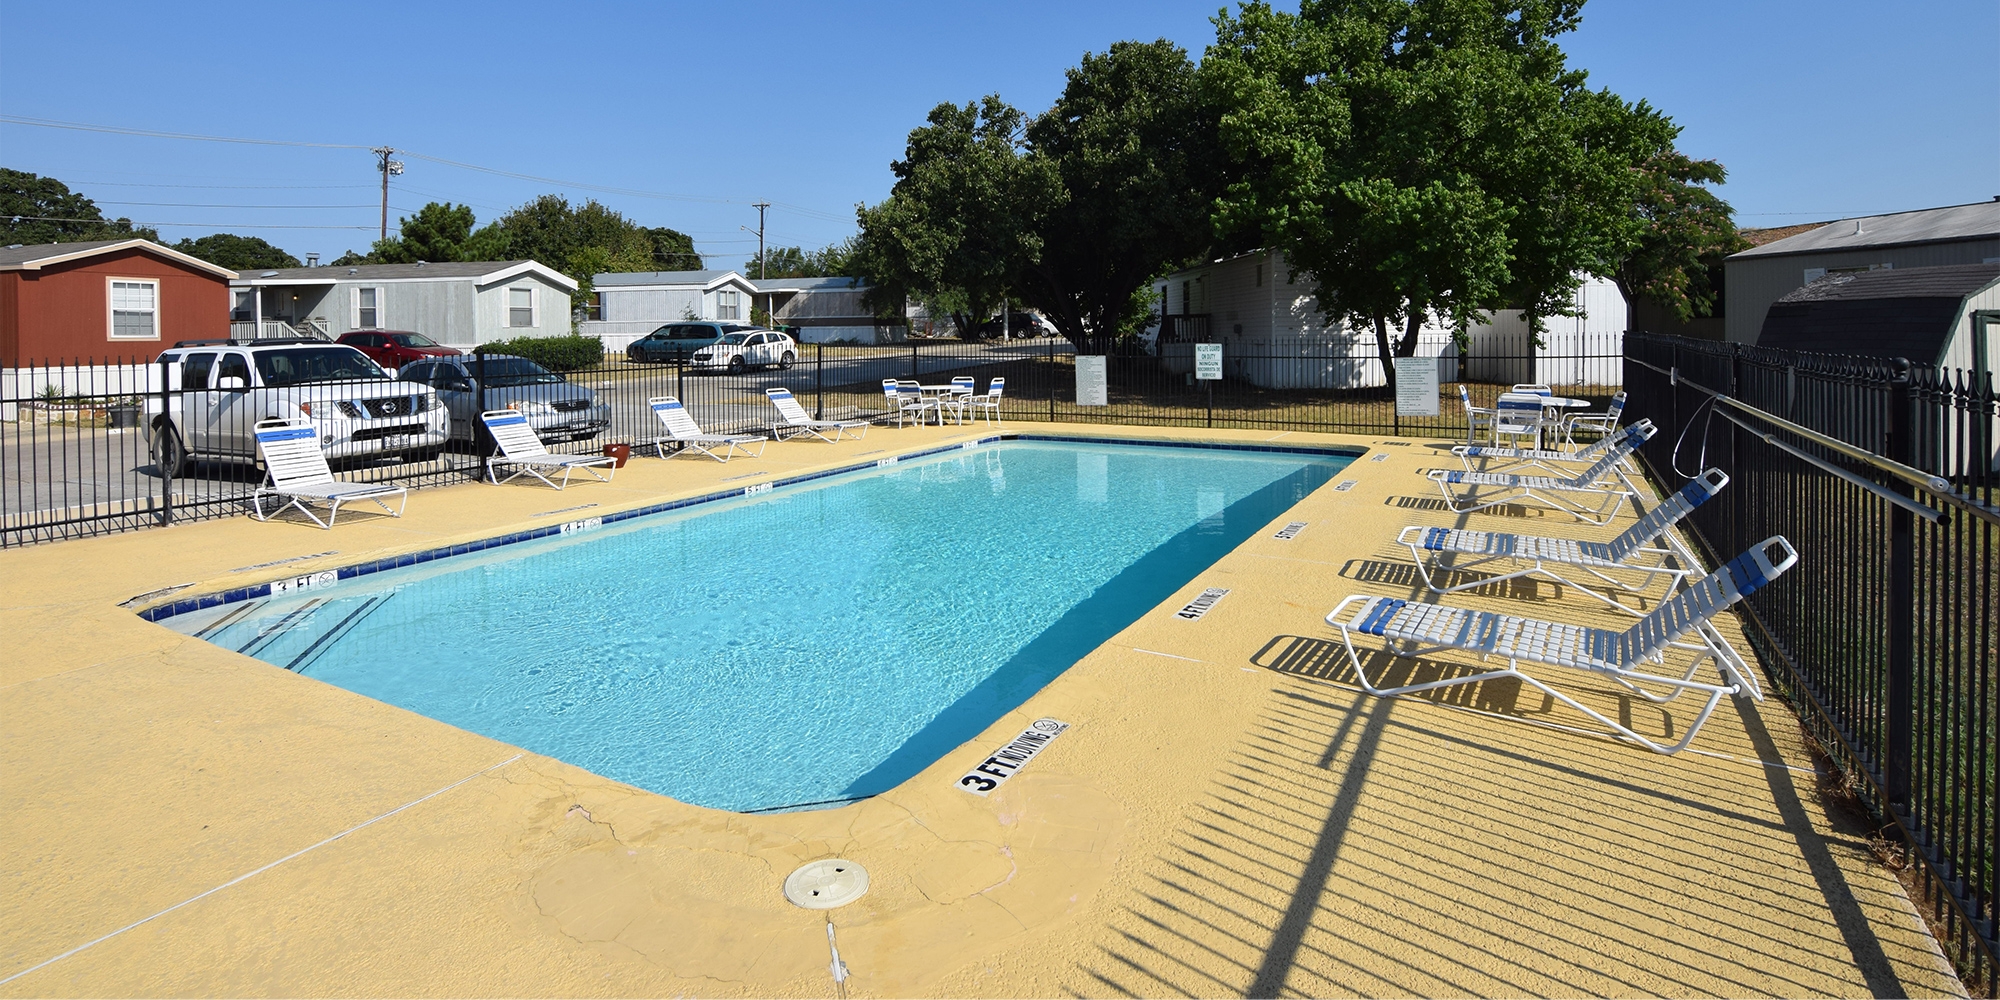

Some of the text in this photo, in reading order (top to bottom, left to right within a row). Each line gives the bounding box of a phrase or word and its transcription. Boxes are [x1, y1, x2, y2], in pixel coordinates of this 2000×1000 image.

[297, 575, 312, 588] FT
[1008, 731, 1051, 755] DIVING
[997, 749, 1028, 763] NO
[961, 775, 997, 792] 3
